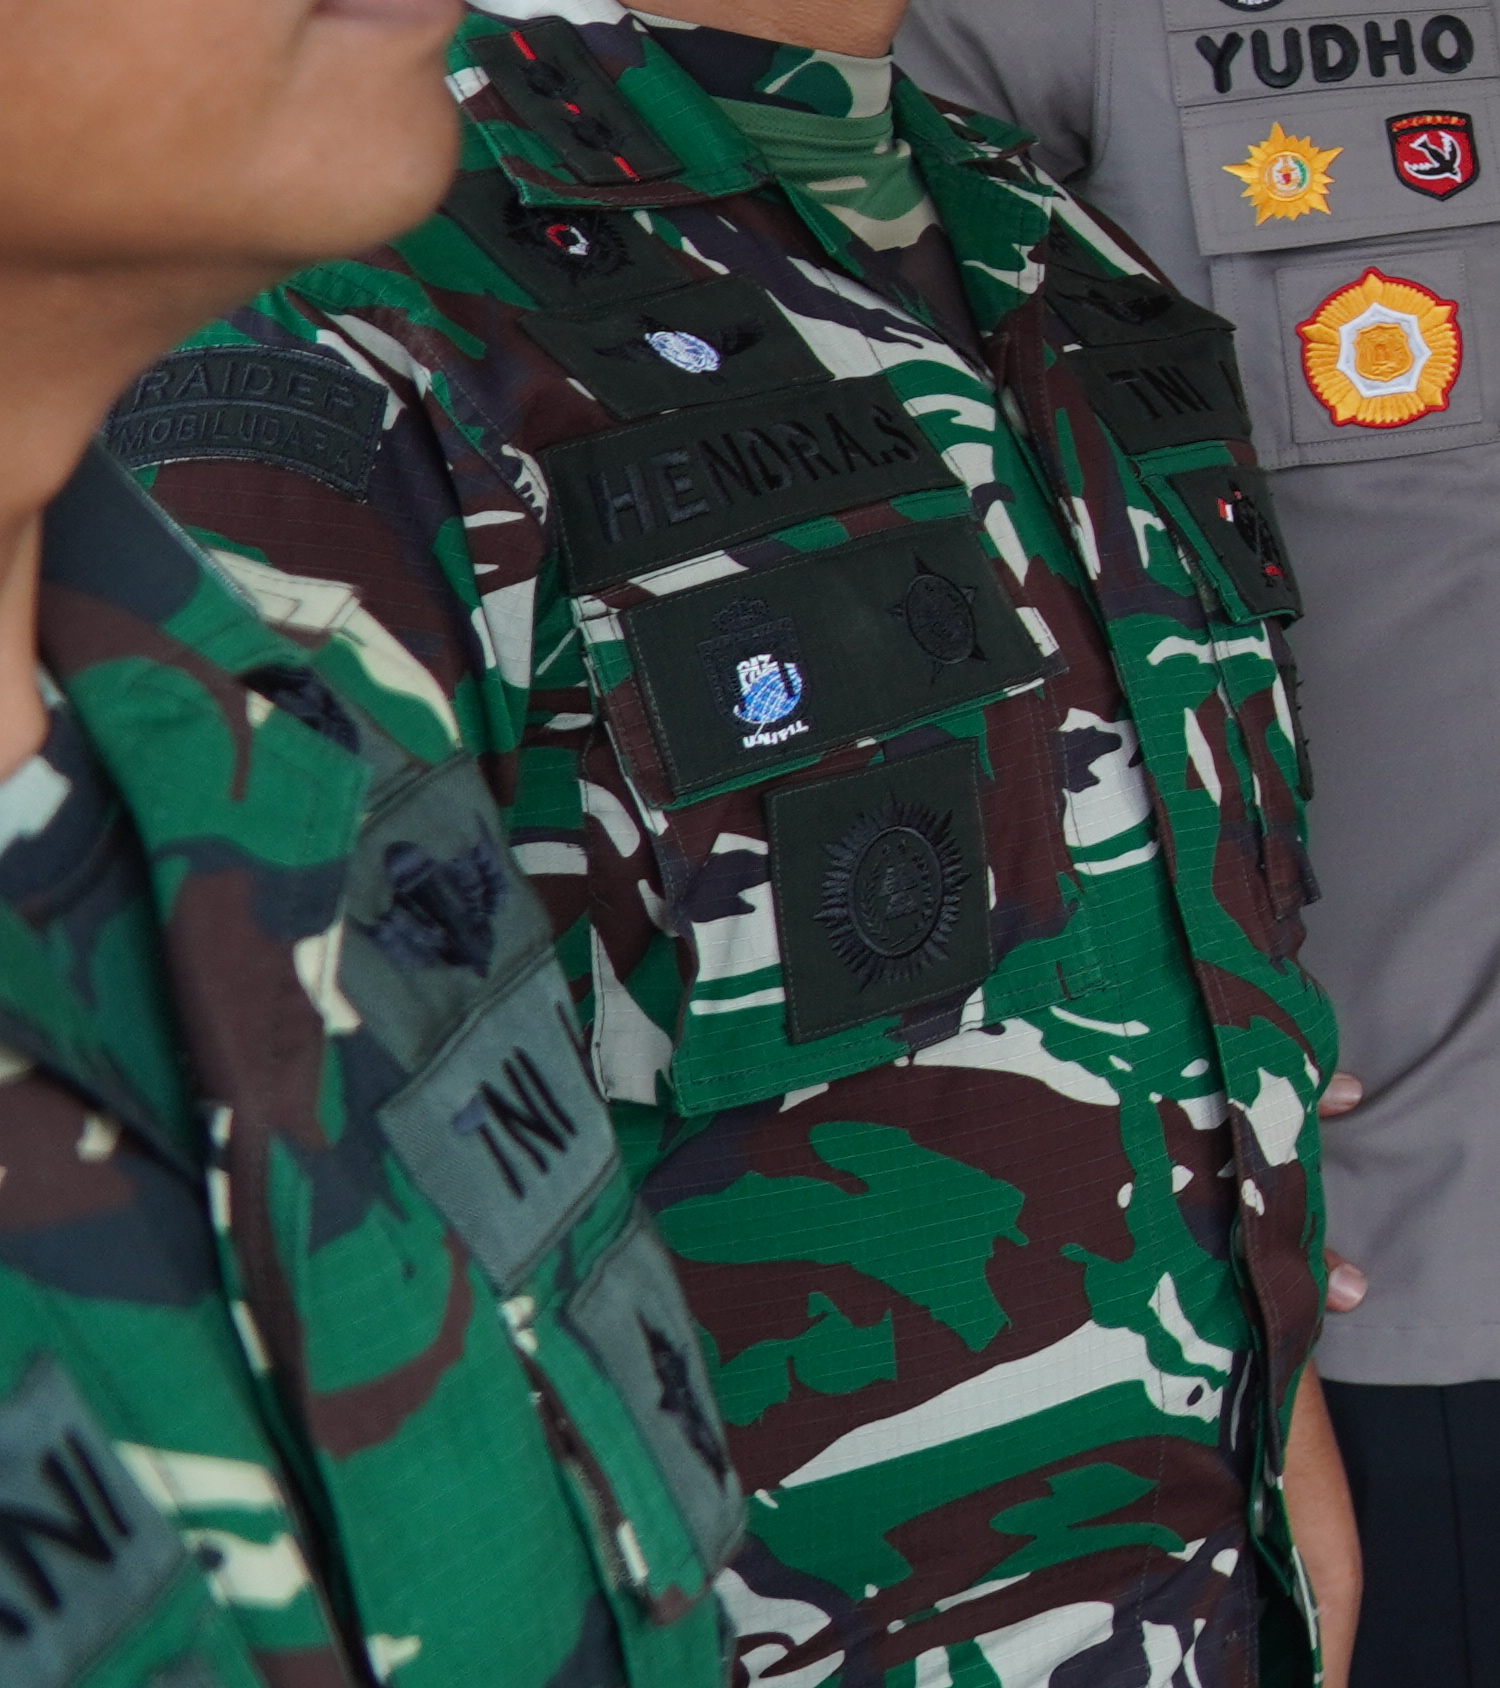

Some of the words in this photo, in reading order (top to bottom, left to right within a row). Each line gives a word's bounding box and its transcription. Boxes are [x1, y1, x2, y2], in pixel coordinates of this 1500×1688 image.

[1196, 14, 1475, 94] YUDHO
[1105, 364, 1215, 421] TNI
[452, 1045, 579, 1202] TNI
[0, 1424, 134, 1640] NI
